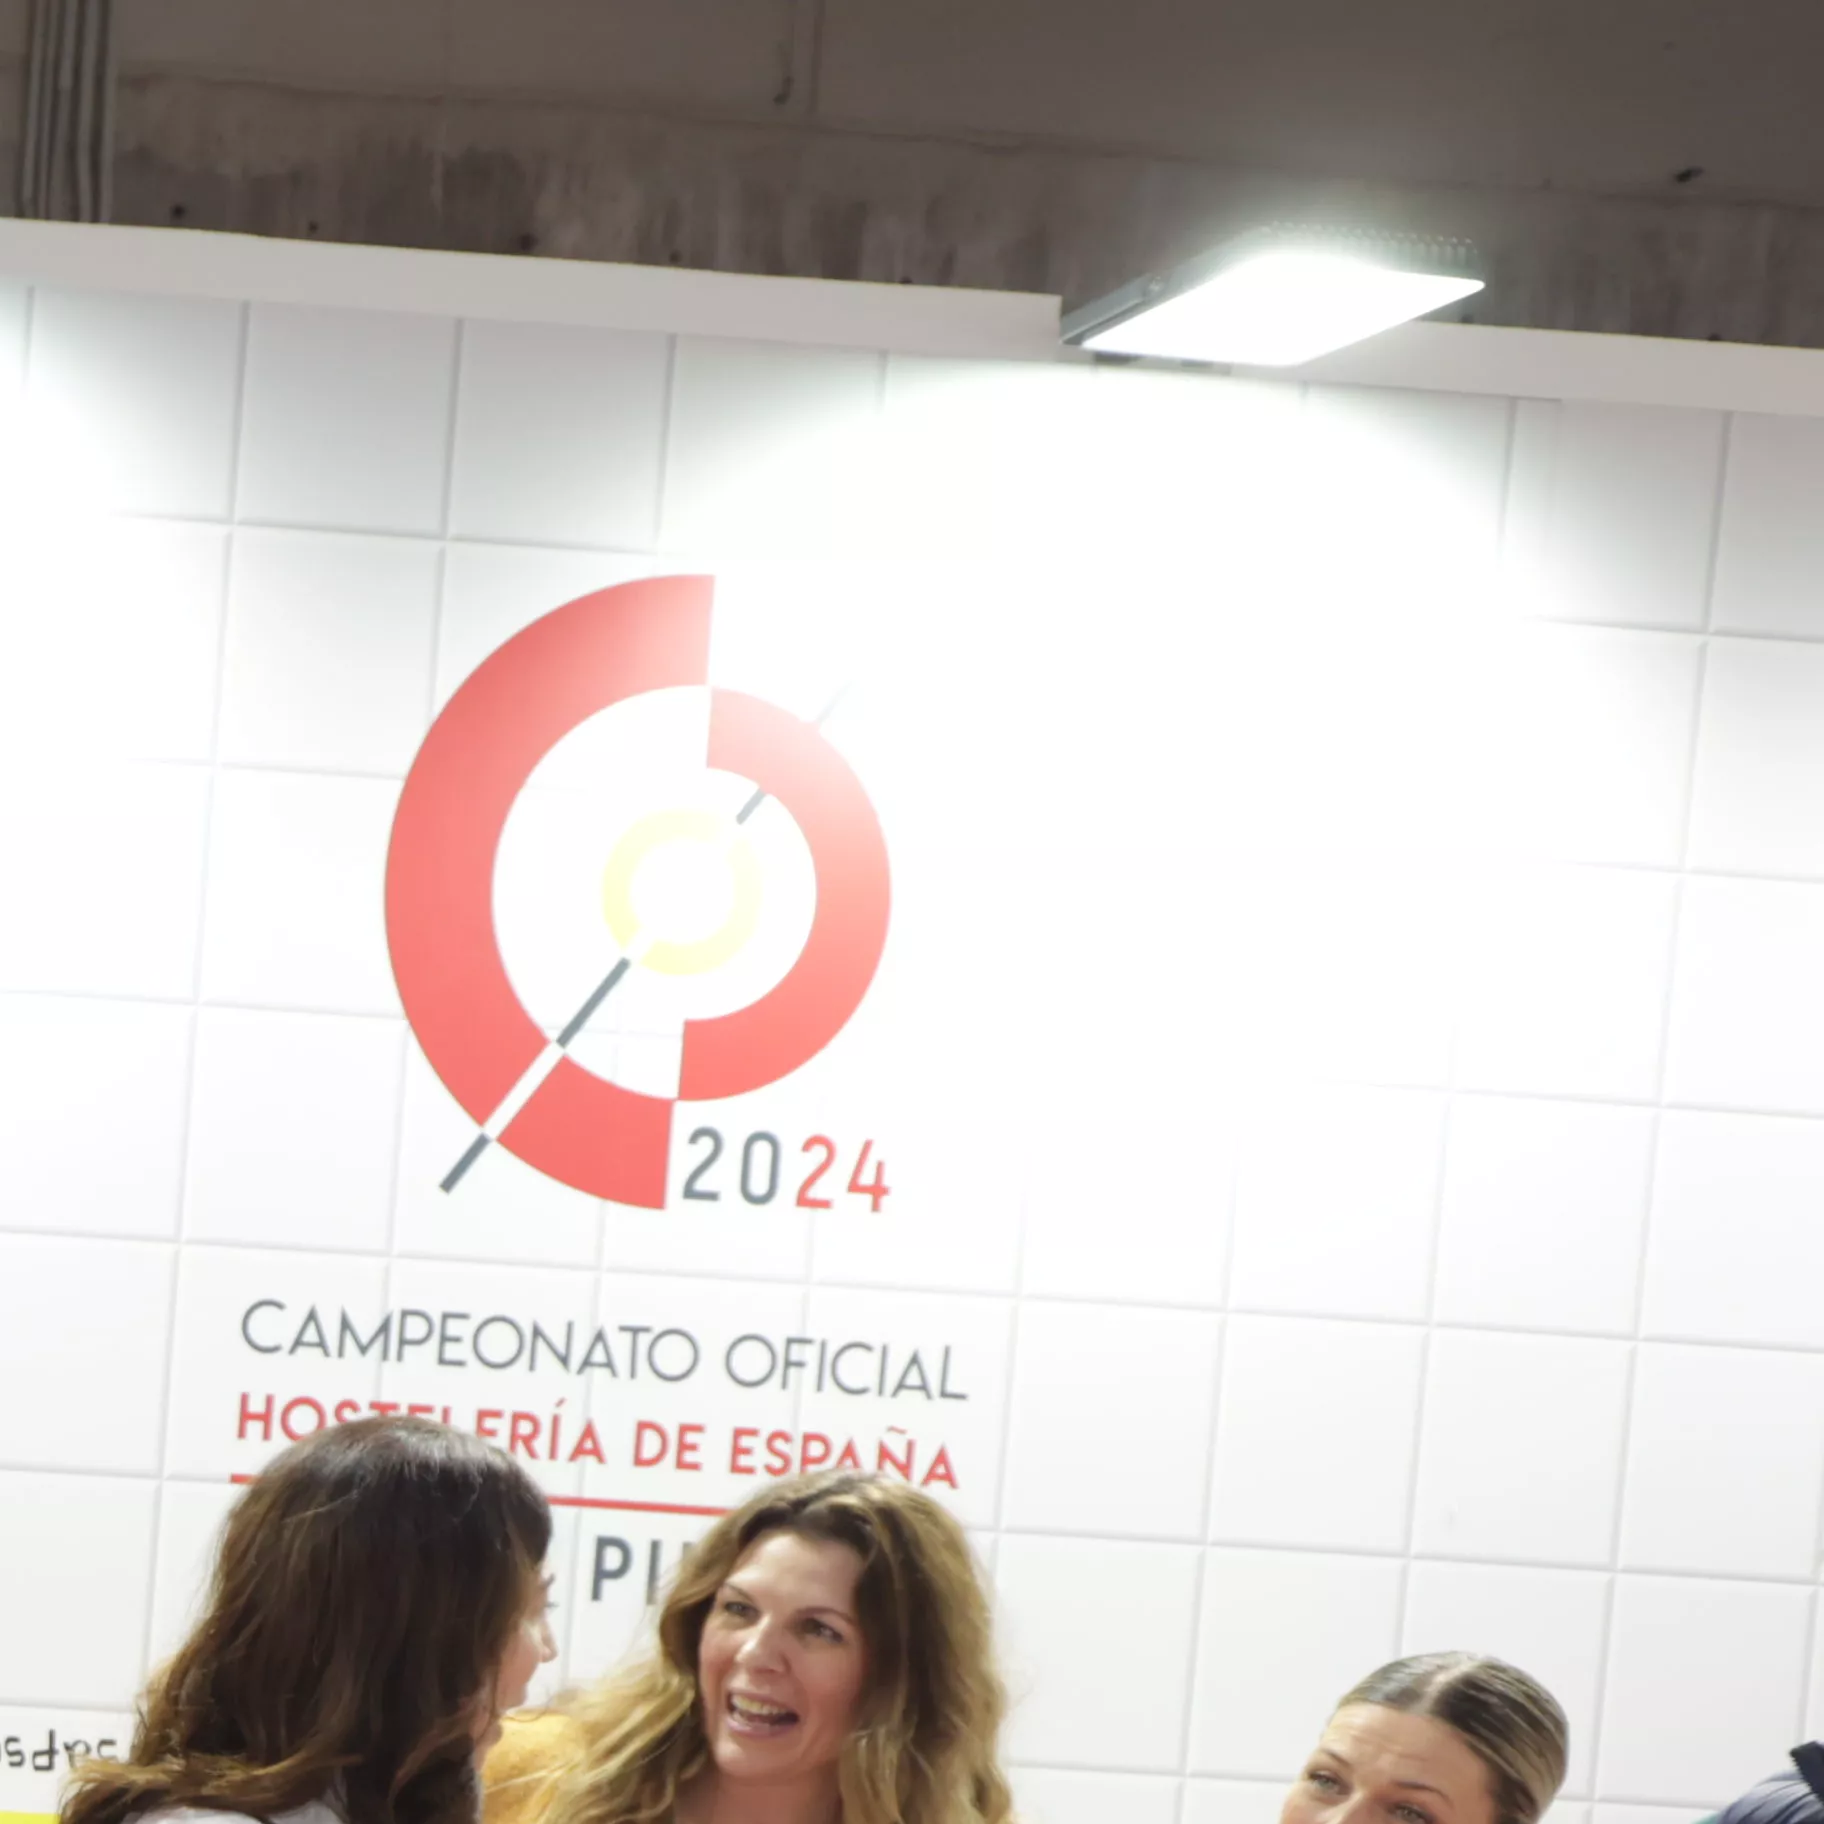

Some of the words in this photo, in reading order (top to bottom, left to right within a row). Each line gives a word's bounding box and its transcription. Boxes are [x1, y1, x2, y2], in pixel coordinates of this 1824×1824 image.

[683, 1127, 890, 1212] 2024
[242, 1299, 700, 1382] CAMPEONATO
[725, 1334, 967, 1400] OFICIAL
[634, 1420, 703, 1471] DE
[730, 1425, 959, 1489] ESPAÑA
